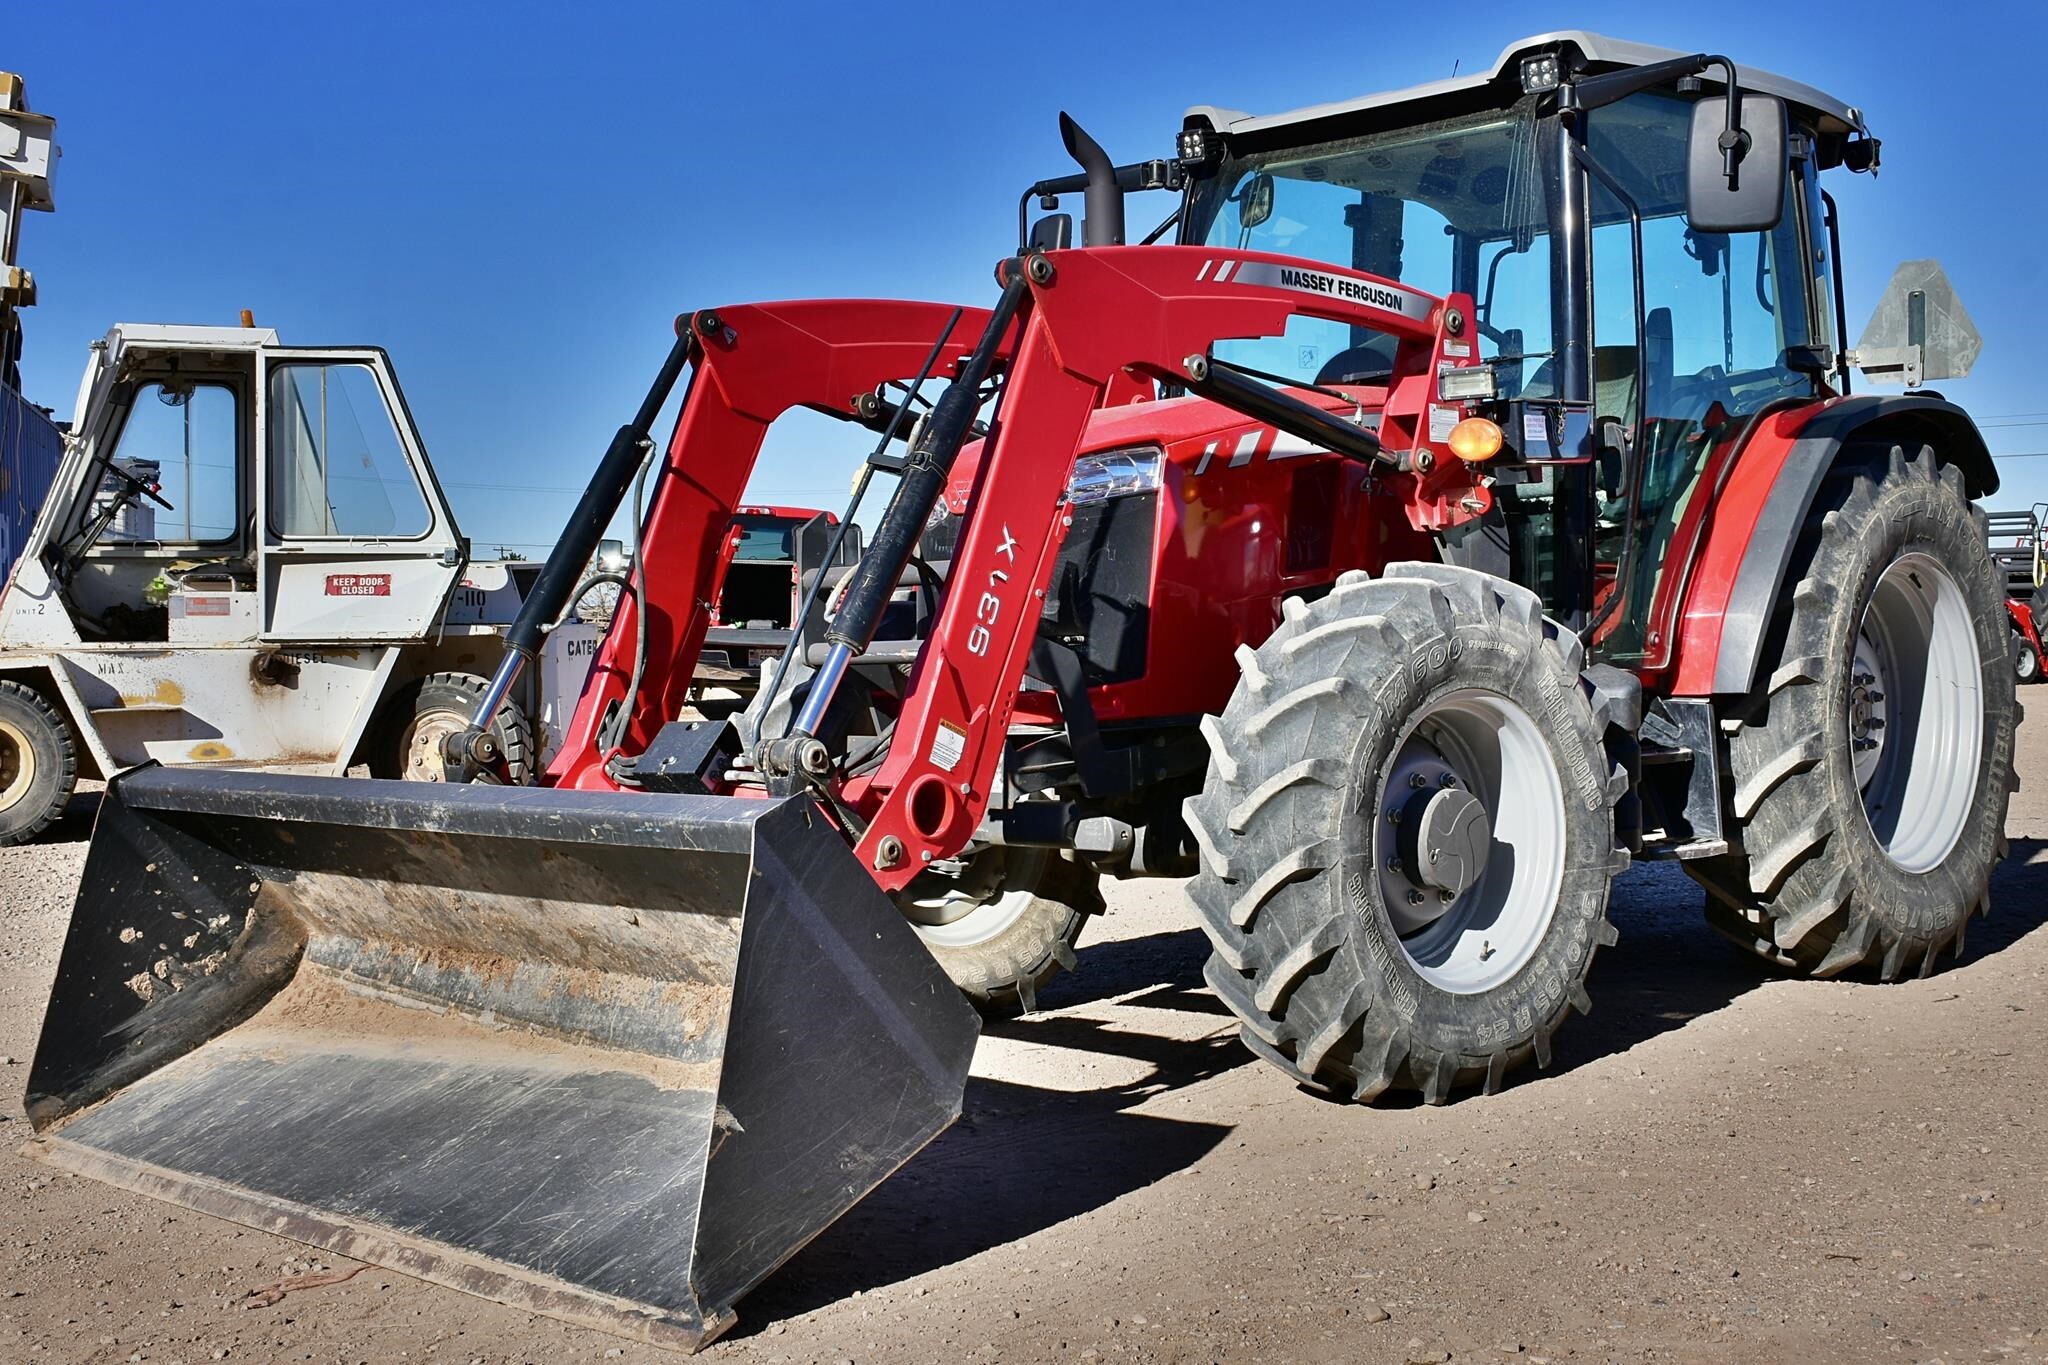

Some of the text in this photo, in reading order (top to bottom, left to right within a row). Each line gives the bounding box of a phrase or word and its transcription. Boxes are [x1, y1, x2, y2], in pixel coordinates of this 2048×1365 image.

[1281, 269, 1403, 311] MASSEY FERGUSON
[333, 578, 385, 586] KEEP DOOR
[341, 586, 375, 595] CLOSED
[967, 521, 1017, 657] 931X
[38, 603, 45, 615] 2
[1411, 635, 1464, 684] 600
[1538, 664, 1602, 813] TRELLEBORG
[1347, 872, 1419, 1025] TRELLEBORG
